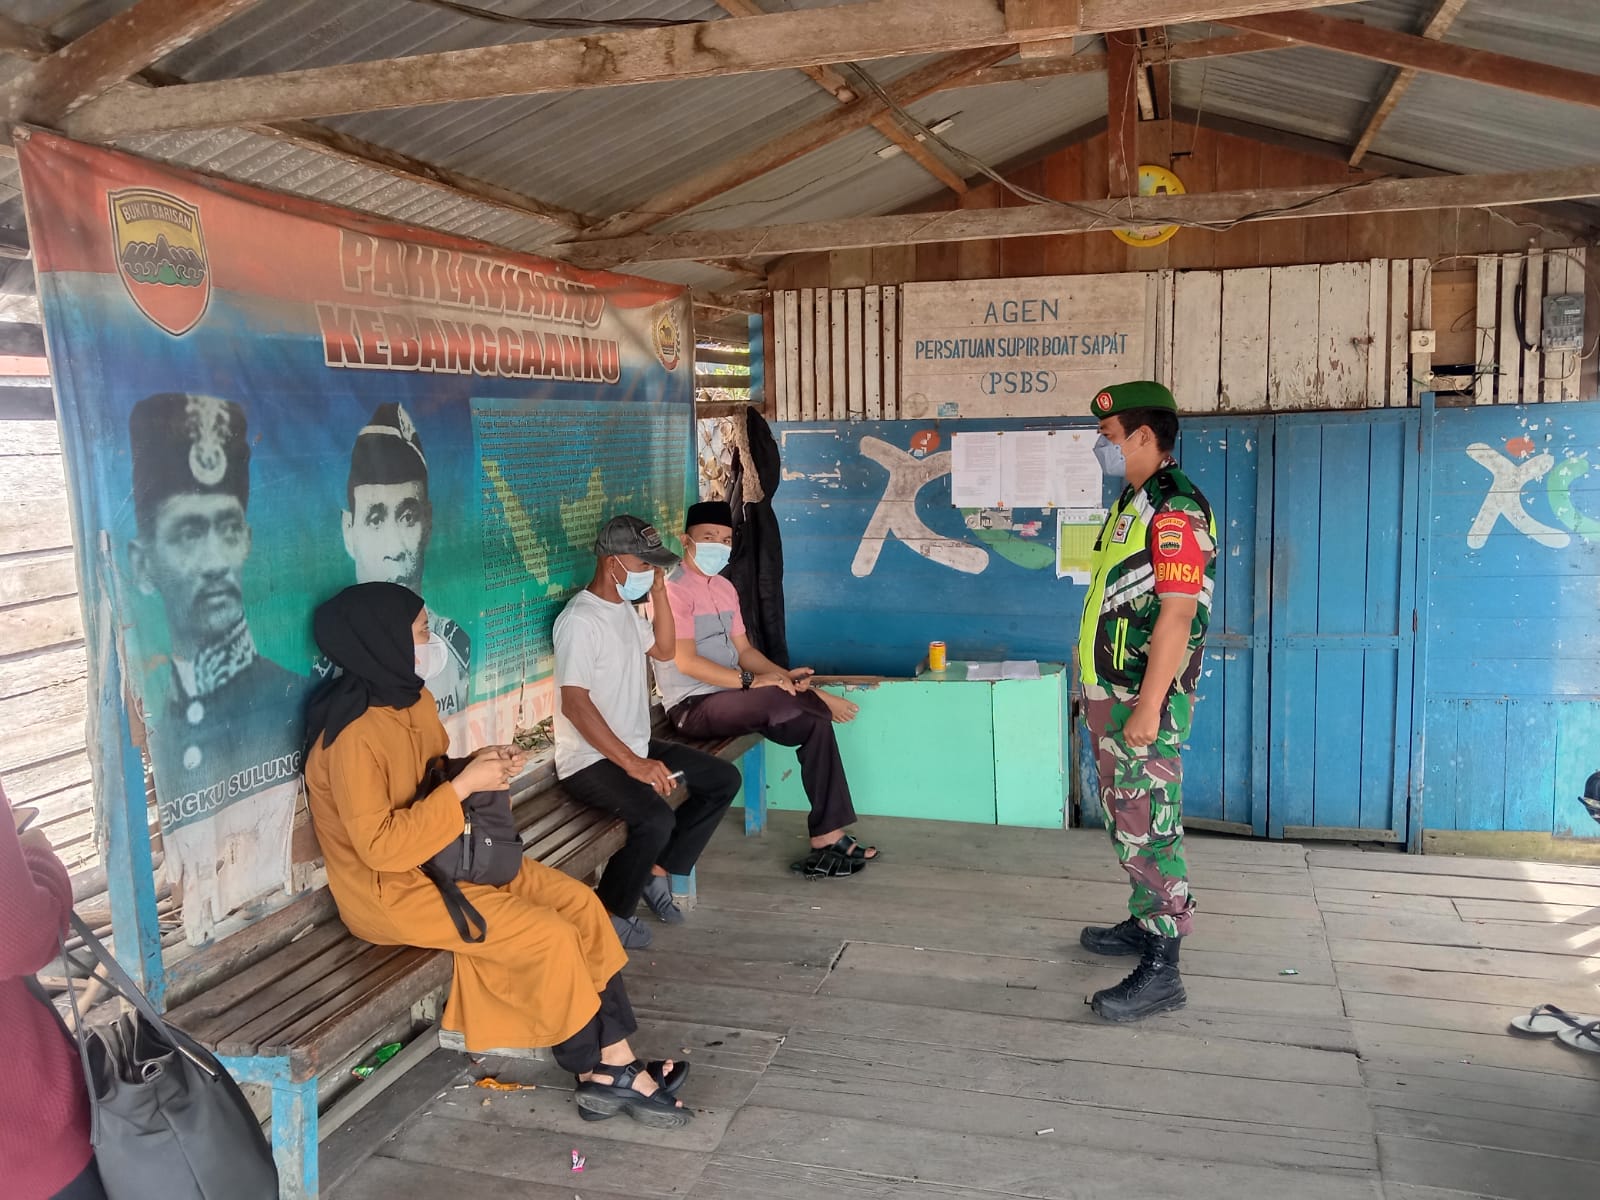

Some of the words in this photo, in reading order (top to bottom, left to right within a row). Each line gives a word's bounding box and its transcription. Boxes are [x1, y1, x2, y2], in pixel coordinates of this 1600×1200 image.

[122, 203, 150, 220] BUKIT
[151, 205, 192, 230] BARISAN
[339, 228, 605, 327] PAHLAWANKU
[983, 299, 1060, 324] AGEN
[315, 303, 622, 384] KEBANGGAANKU
[915, 337, 996, 360] PERSATUAN
[997, 336, 1040, 357] SUPIR
[1041, 335, 1078, 355] BOAT
[980, 369, 1058, 395] (PSBS)
[228, 751, 301, 798] SULUNG
